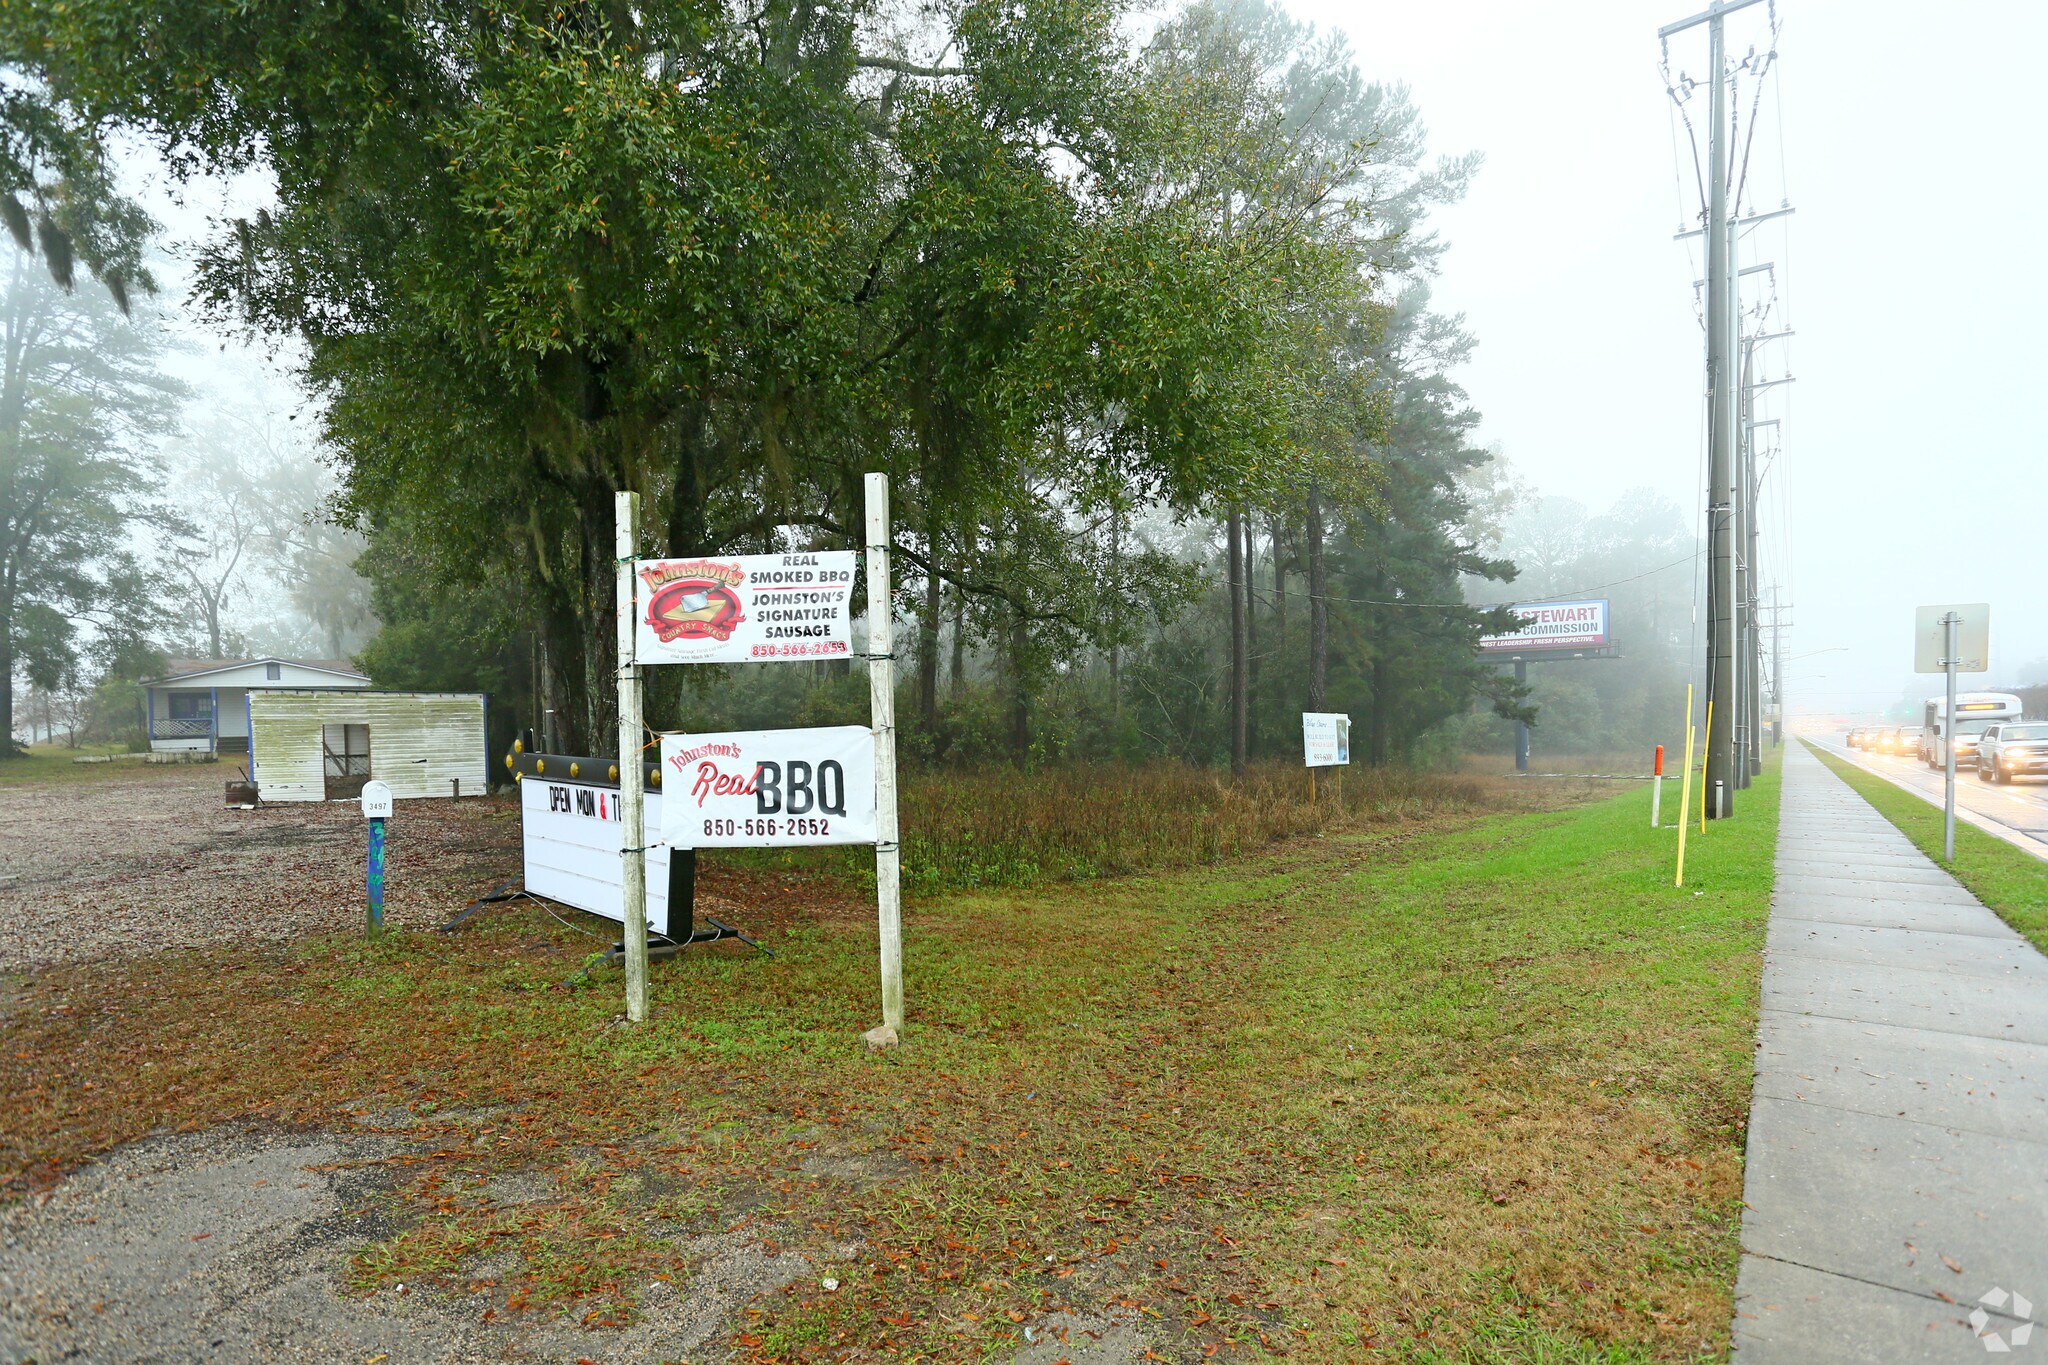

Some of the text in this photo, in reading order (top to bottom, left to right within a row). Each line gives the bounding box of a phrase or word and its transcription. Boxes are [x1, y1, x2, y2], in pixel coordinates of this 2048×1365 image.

[782, 555, 819, 567] REAL
[639, 559, 745, 594] Johnston's
[750, 571, 850, 584] SMOKED BBQ
[752, 591, 844, 606] JOHNSTON'S
[757, 607, 838, 622] SIGNATURE
[1521, 607, 1598, 623] STEWART
[661, 622, 697, 640] COUNTRY
[765, 624, 831, 639] SAUSAGE
[1523, 622, 1598, 636] COMMISSION
[668, 742, 742, 773] Johnston's
[691, 759, 847, 818] Real BBQ
[369, 803, 387, 811] 3497
[549, 785, 622, 822] OPEN MON & T
[703, 818, 830, 837] 850-566-2652
